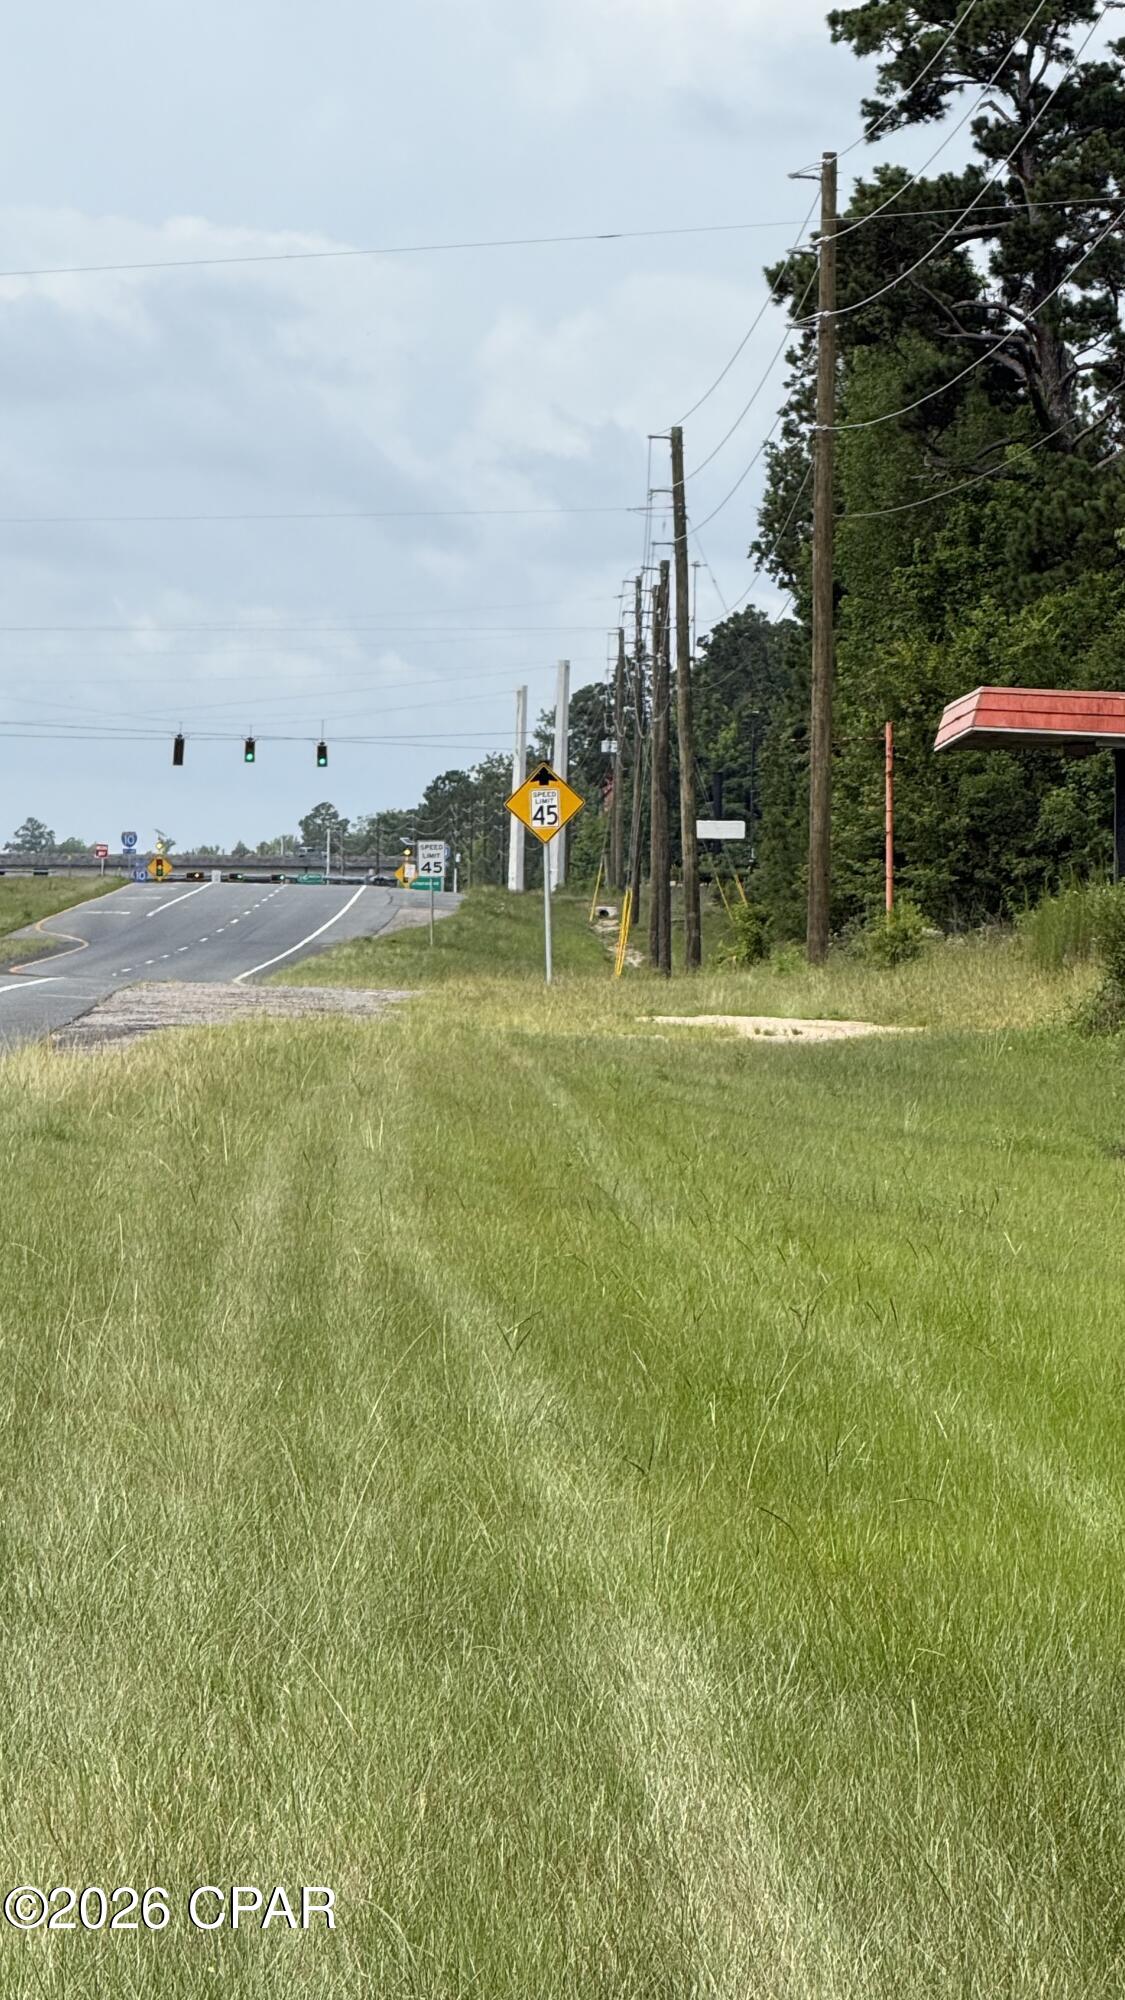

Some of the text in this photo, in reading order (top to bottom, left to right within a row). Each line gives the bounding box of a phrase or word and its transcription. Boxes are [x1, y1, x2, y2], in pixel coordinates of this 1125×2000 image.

[532, 804, 558, 826] 45
[124, 834, 135, 845] 10
[421, 861, 443, 874] 45
[136, 871, 146, 881] 10
